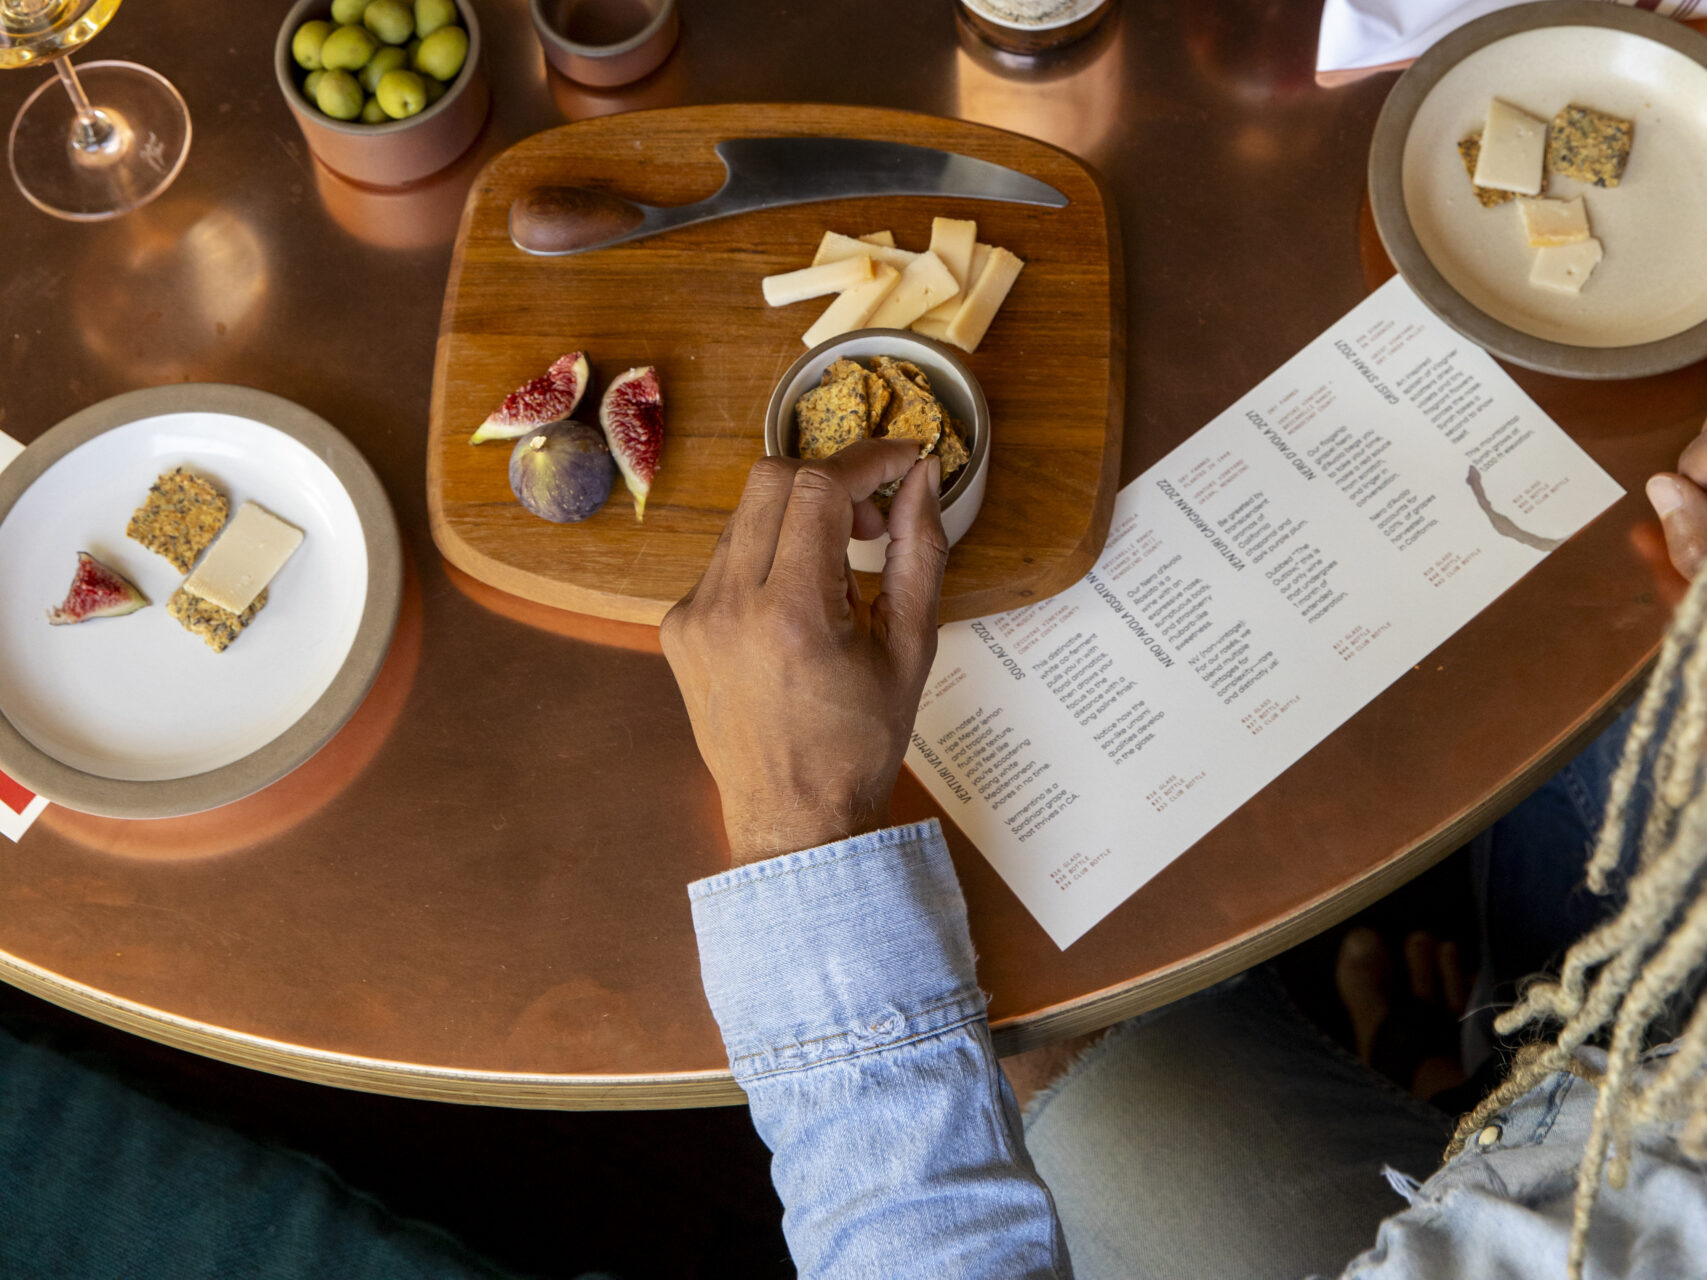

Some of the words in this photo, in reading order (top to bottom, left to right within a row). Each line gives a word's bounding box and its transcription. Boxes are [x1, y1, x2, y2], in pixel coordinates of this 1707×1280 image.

[1333, 339, 1358, 361] 2021
[1351, 357, 1380, 384] SYRAH
[1373, 382, 1400, 405] GRIST
[1244, 409, 1269, 431] 2021
[1291, 458, 1317, 481] NERO
[1155, 478, 1181, 501] 2022
[1173, 498, 1216, 539] CARIGNAN
[1210, 536, 1246, 572] VENTURI
[1093, 582, 1126, 614] ROSATO
[1126, 585, 1141, 599] Our
[1139, 572, 1159, 588] Nero
[1132, 585, 1160, 606] Rosato
[1163, 575, 1172, 583] a
[1141, 598, 1159, 614] wine
[1157, 586, 1174, 600] with
[1171, 579, 1184, 589] an
[1147, 591, 1184, 621] expressive
[1154, 597, 1193, 629] sumptuous
[1161, 621, 1177, 636] and
[1175, 594, 1213, 625] strawberry
[970, 620, 996, 644] 2022
[1168, 610, 1209, 644] rhubarb-like
[987, 642, 1009, 659] ACT
[1031, 659, 1049, 672] This
[1047, 632, 1083, 661] distinctive
[1040, 663, 1060, 680] white
[1058, 632, 1098, 665] co-ferment
[1046, 673, 1064, 690] pulls
[1062, 663, 1078, 676] you
[1075, 657, 1085, 666] in
[1082, 644, 1100, 660] with
[1149, 644, 1175, 668] NERO
[1194, 662, 1208, 674] For
[1207, 653, 1220, 665] our
[1239, 628, 1252, 639] we
[1201, 663, 1224, 682] blend
[1222, 643, 1250, 666] multiple
[1002, 658, 1027, 681] SOLO
[1052, 678, 1073, 695] floral
[1070, 652, 1109, 682] aromatics,
[1059, 688, 1078, 704] then
[1076, 671, 1100, 691] draws
[1097, 658, 1114, 674] your
[1209, 664, 1240, 689] vintages
[1237, 656, 1249, 666] for
[1223, 690, 1240, 705] and
[1237, 667, 1269, 694] distinctly
[1065, 693, 1088, 711] focus
[1085, 687, 1096, 696] to
[1093, 677, 1108, 689] the
[1073, 692, 1105, 719] distance
[1103, 680, 1120, 695] with
[1118, 676, 1126, 684] a
[1079, 711, 1098, 727] long
[1095, 695, 1118, 715] saline
[936, 730, 957, 746] With
[954, 715, 977, 733] notes
[975, 707, 984, 718] of
[944, 740, 960, 754] ripe
[957, 723, 981, 743] Meyer
[979, 707, 1003, 726] lemon
[1092, 722, 1118, 743] Notice
[1115, 709, 1133, 724] how
[1131, 700, 1146, 712] the
[1100, 727, 1128, 751] soy-like
[1126, 708, 1151, 730] umami
[1107, 732, 1138, 758] qualities
[1136, 711, 1165, 735] develop
[951, 746, 968, 763] and
[964, 726, 994, 751] tropical
[956, 746, 987, 770] fruit-like
[985, 726, 1015, 748] texture,
[981, 750, 997, 764] feel
[995, 741, 1010, 753] like
[992, 738, 1032, 770] scootering
[1121, 747, 1136, 760] the
[1134, 733, 1156, 752] glass.
[936, 766, 973, 805] VENTURI
[977, 776, 1001, 795] along
[998, 760, 1019, 778] white
[983, 760, 1037, 802] Mediterranean
[991, 789, 1017, 811] shores
[1014, 784, 1024, 792] in
[1022, 775, 1034, 786] no
[1031, 763, 1051, 778] time.
[1003, 792, 1046, 826] Vermentino
[1044, 787, 1053, 795] is
[1051, 782, 1059, 790] a
[1010, 806, 1046, 835] Sardinian
[1044, 789, 1068, 810] grape
[1018, 827, 1036, 843] that
[1033, 808, 1060, 830] thrives
[1057, 802, 1067, 811] in
[1065, 793, 1081, 805] CA.
[1062, 852, 1082, 869] GLASS
[1067, 855, 1090, 875] BOTTLE
[1072, 866, 1089, 881] CLUB
[1088, 848, 1112, 868] BOTTLE
